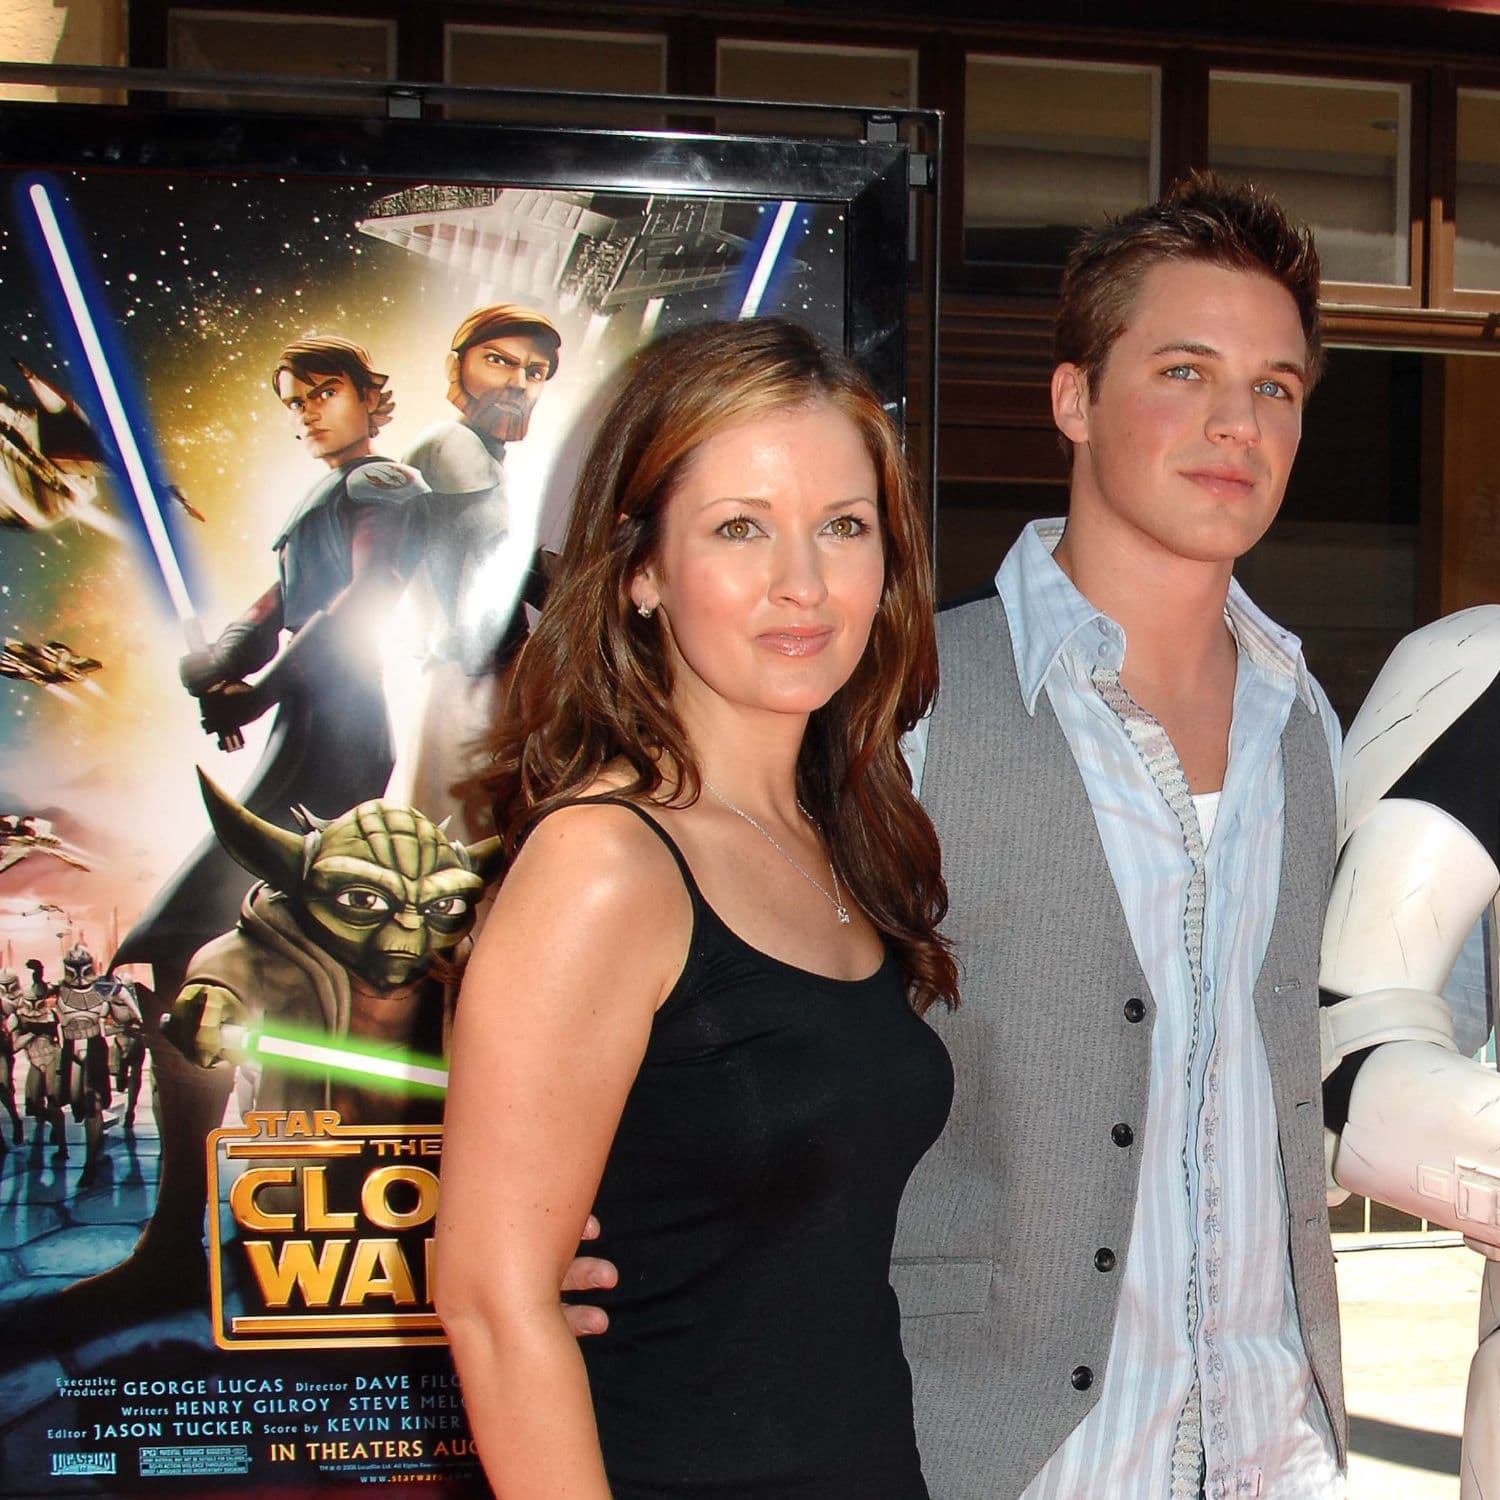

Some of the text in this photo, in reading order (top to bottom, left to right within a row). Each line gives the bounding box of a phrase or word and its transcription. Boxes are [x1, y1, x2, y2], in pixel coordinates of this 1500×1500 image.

[244, 1110, 342, 1137] STAR
[369, 1139, 442, 1156] THE
[230, 1165, 441, 1231] CLO
[243, 1239, 436, 1307] WA
[56, 1376, 117, 1387] Executive
[60, 1387, 118, 1397] Producer
[123, 1380, 207, 1396] GEORGE
[218, 1378, 284, 1394] LUCAS
[296, 1382, 348, 1392] Director
[356, 1375, 410, 1391] DAVE
[121, 1396, 464, 1416] Writers HENRY GILROY STEVE MEL
[47, 1416, 460, 1440] Editor JASON TUCKER Score by KEVIN KINER
[270, 1443, 296, 1461] IN
[306, 1440, 423, 1461] THEATERS
